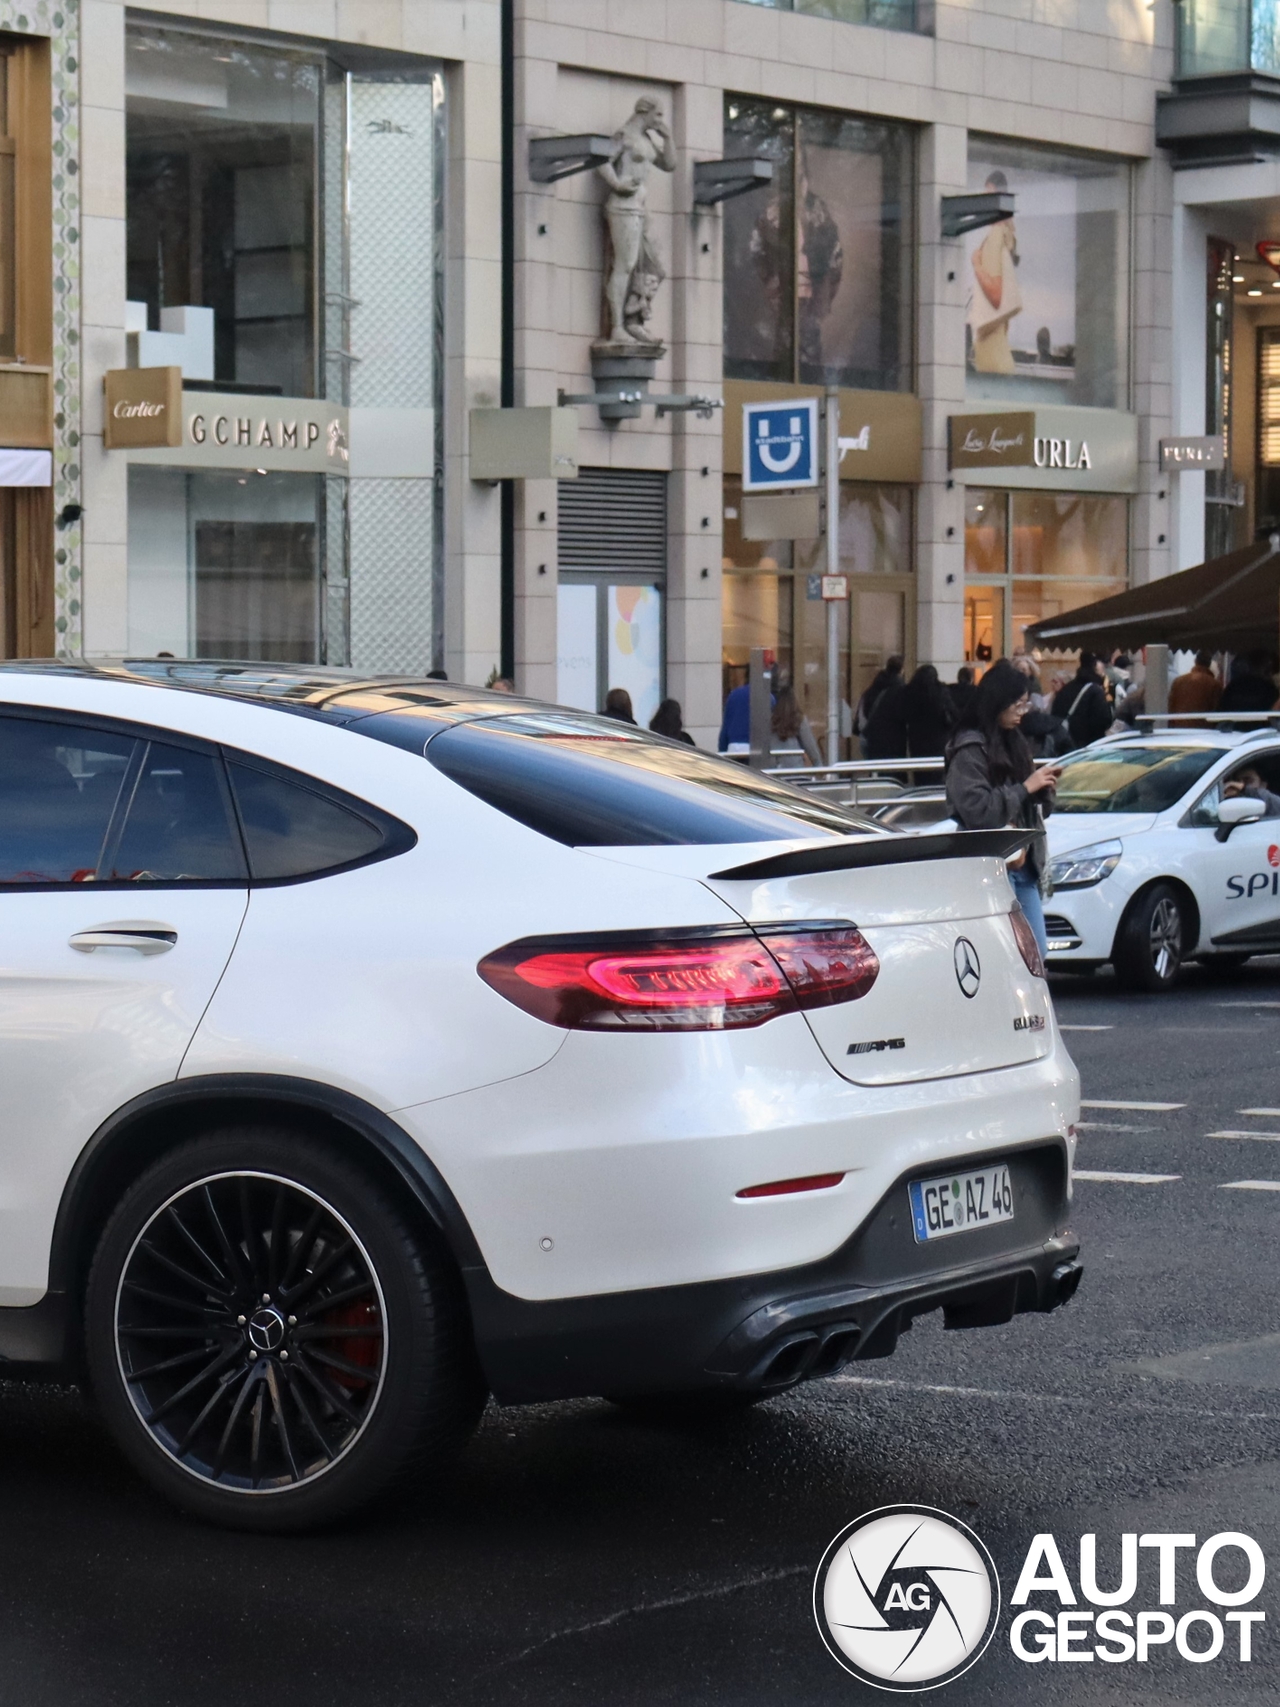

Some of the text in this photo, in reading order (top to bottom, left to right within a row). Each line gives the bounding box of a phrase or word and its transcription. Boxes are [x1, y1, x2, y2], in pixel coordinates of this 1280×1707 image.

[113, 401, 165, 418] Cartier
[190, 414, 320, 449] GCHAMP
[1034, 437, 1091, 470] URLA
[925, 1171, 1012, 1231] GE AZ 46
